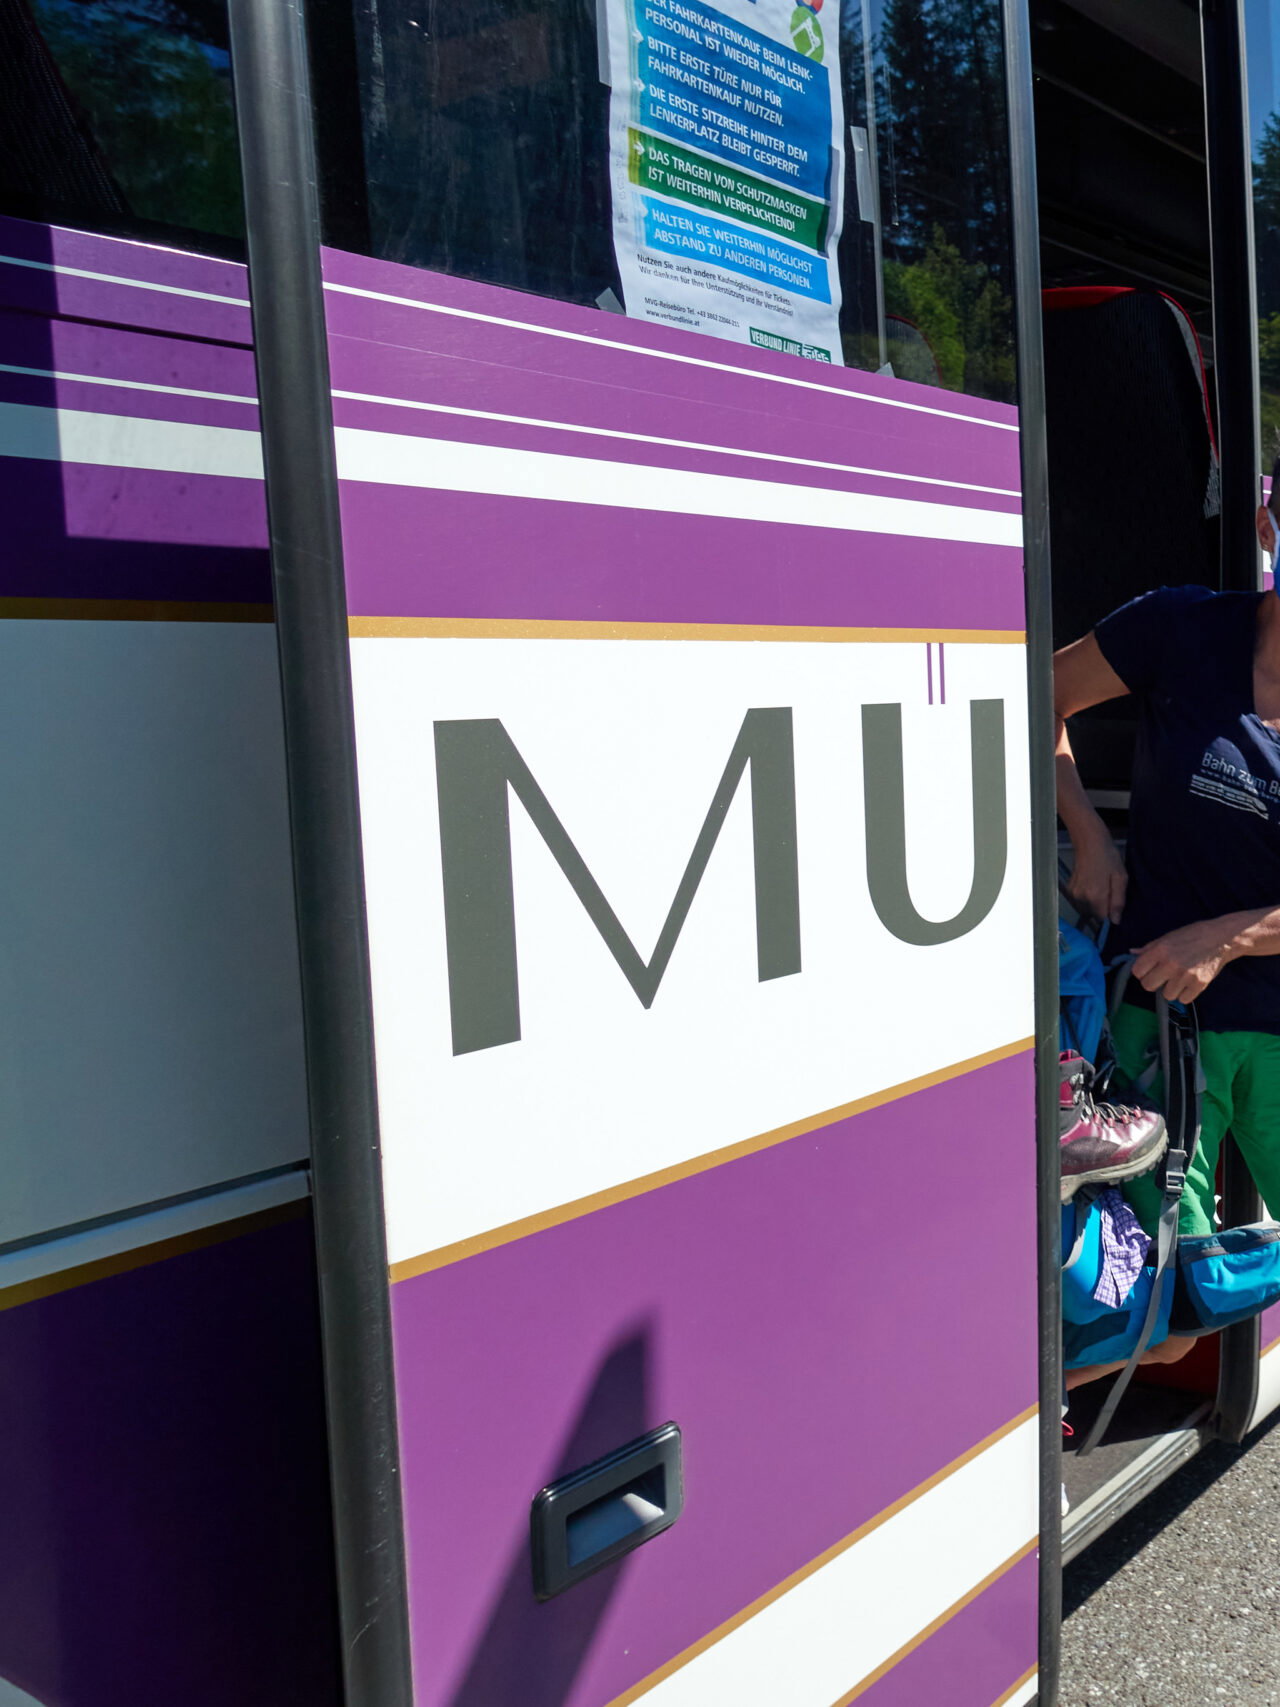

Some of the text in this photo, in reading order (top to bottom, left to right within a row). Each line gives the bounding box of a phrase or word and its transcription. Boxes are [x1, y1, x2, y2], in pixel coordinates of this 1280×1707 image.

[645, 7, 806, 94] PERSONAL IST WIEDER MÖGLICH.
[647, 36, 782, 108] BITTE ERSTE TÜRE NUR FÜR
[648, 0, 814, 81] ER FAHRKARTENKAUF BEIM LENK-
[648, 55, 784, 127] FAHRKARTENKAUF NUTZEN.
[649, 84, 808, 162] DIE ERSTE SITZREIHE HINTER DEM
[650, 103, 800, 177] LENKERPLATZ BLEIBT GESPERRT.
[648, 146, 807, 220] DAS TRAGEN VON SCHUTZMASKEN
[648, 166, 796, 232] IST WEITERHIN VERPFLICHTEND!
[637, 254, 662, 267] Nutzen
[664, 260, 674, 270] Sie
[676, 264, 692, 275] auch
[693, 269, 717, 281] andere
[639, 265, 652, 275] Wir
[692, 278, 705, 289] Ihre
[652, 208, 813, 274] HALTEN SIE WEITERHIN MÖGLICHST
[654, 228, 813, 290] ABSTAND ZU ANDEREN PERSONEN.
[751, 329, 783, 352] VERBUND
[1202, 751, 1236, 777] Bahn
[1238, 768, 1267, 790] zum
[433, 642, 1008, 1057] MÜ
